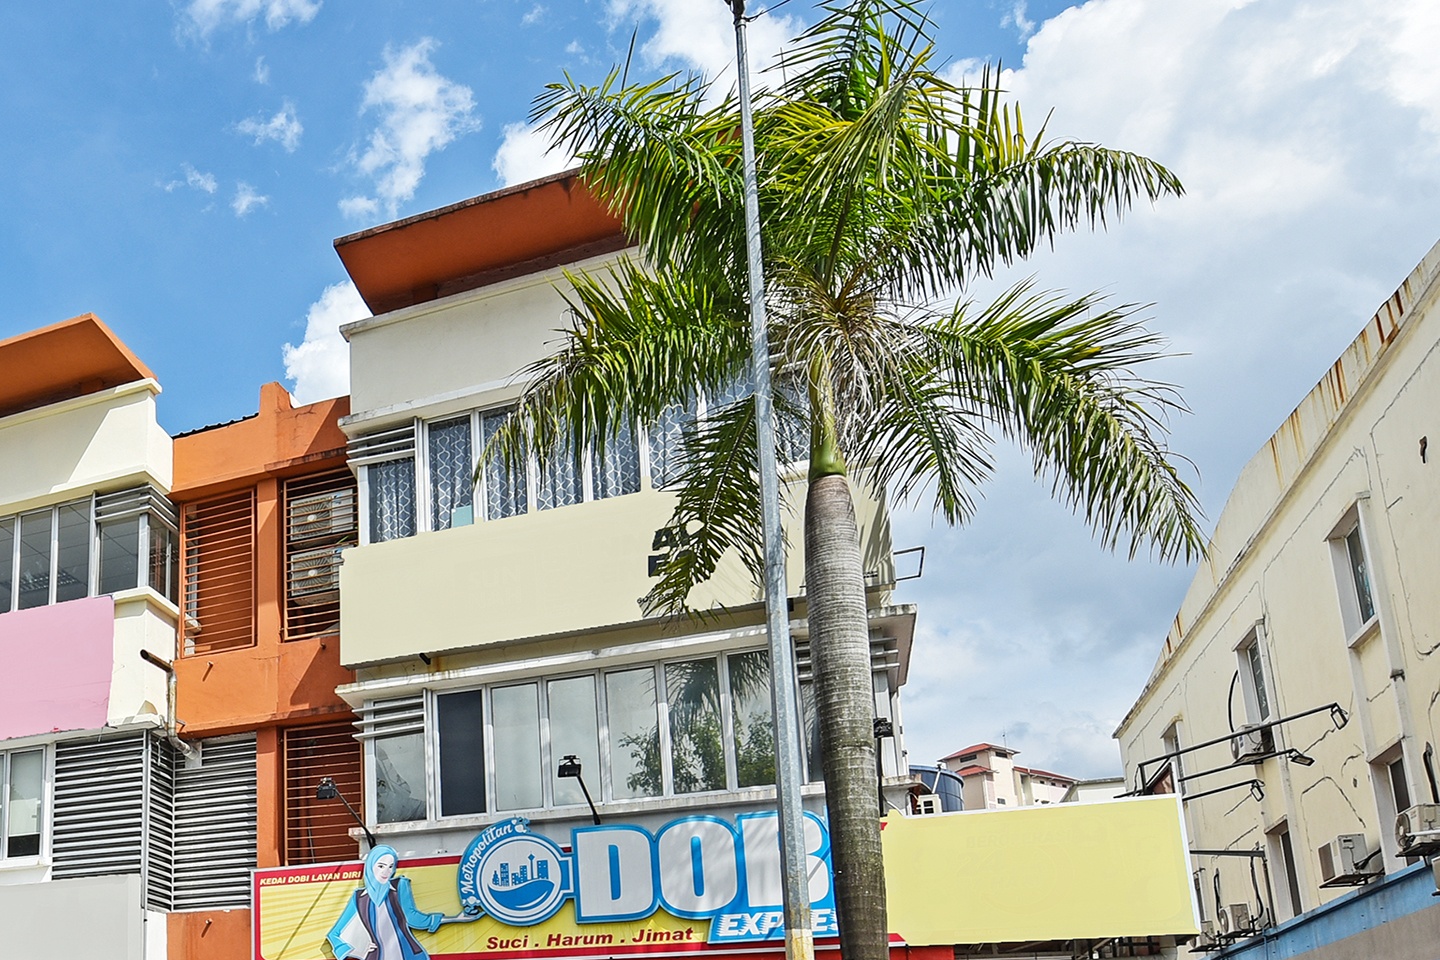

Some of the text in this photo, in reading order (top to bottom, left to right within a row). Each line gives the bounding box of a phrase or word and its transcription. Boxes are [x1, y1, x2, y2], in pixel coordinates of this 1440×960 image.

[460, 824, 513, 895] Metropolitan
[260, 871, 362, 885] KEDAI DOBI LAYAN DIRI
[487, 935, 529, 950] Suci
[547, 932, 613, 947] Harum
[632, 927, 694, 943] Jimat
